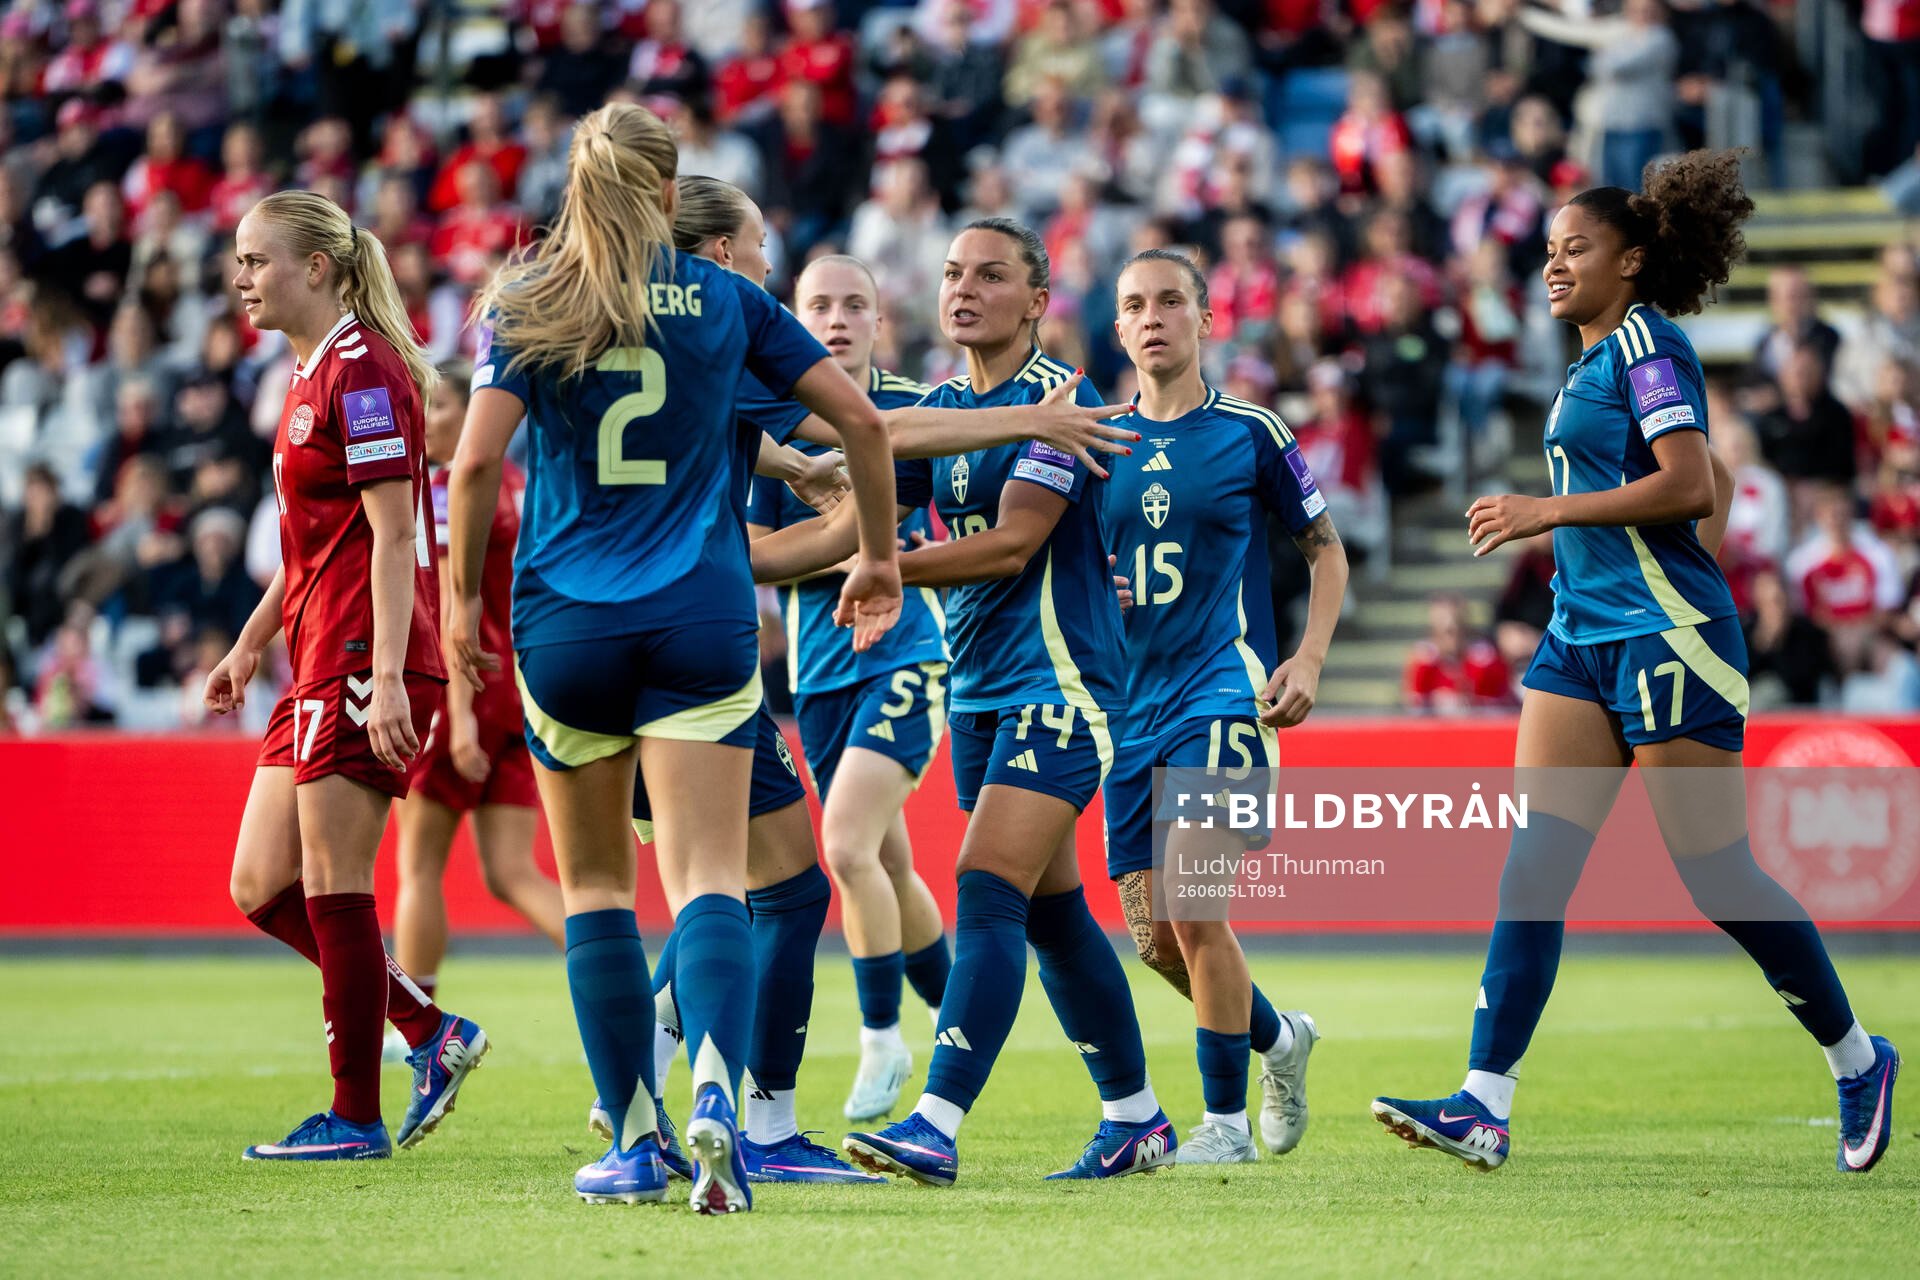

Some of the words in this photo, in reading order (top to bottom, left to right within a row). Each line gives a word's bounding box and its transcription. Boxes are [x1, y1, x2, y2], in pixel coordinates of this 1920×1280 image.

[1641, 386, 1675, 401] EUROPEAN
[1642, 391, 1677, 407] QUALIFIERS
[353, 415, 389, 426] EUROPEAN
[353, 420, 390, 431] QUALIFIERS
[596, 346, 667, 486] 2
[348, 443, 403, 457] FOUNDATION
[1018, 464, 1072, 487] FOUNDATION
[1135, 541, 1184, 606] 15
[880, 669, 922, 718] 5
[1637, 660, 1686, 732] 17
[293, 699, 324, 763] 17
[1206, 719, 1257, 781] 15
